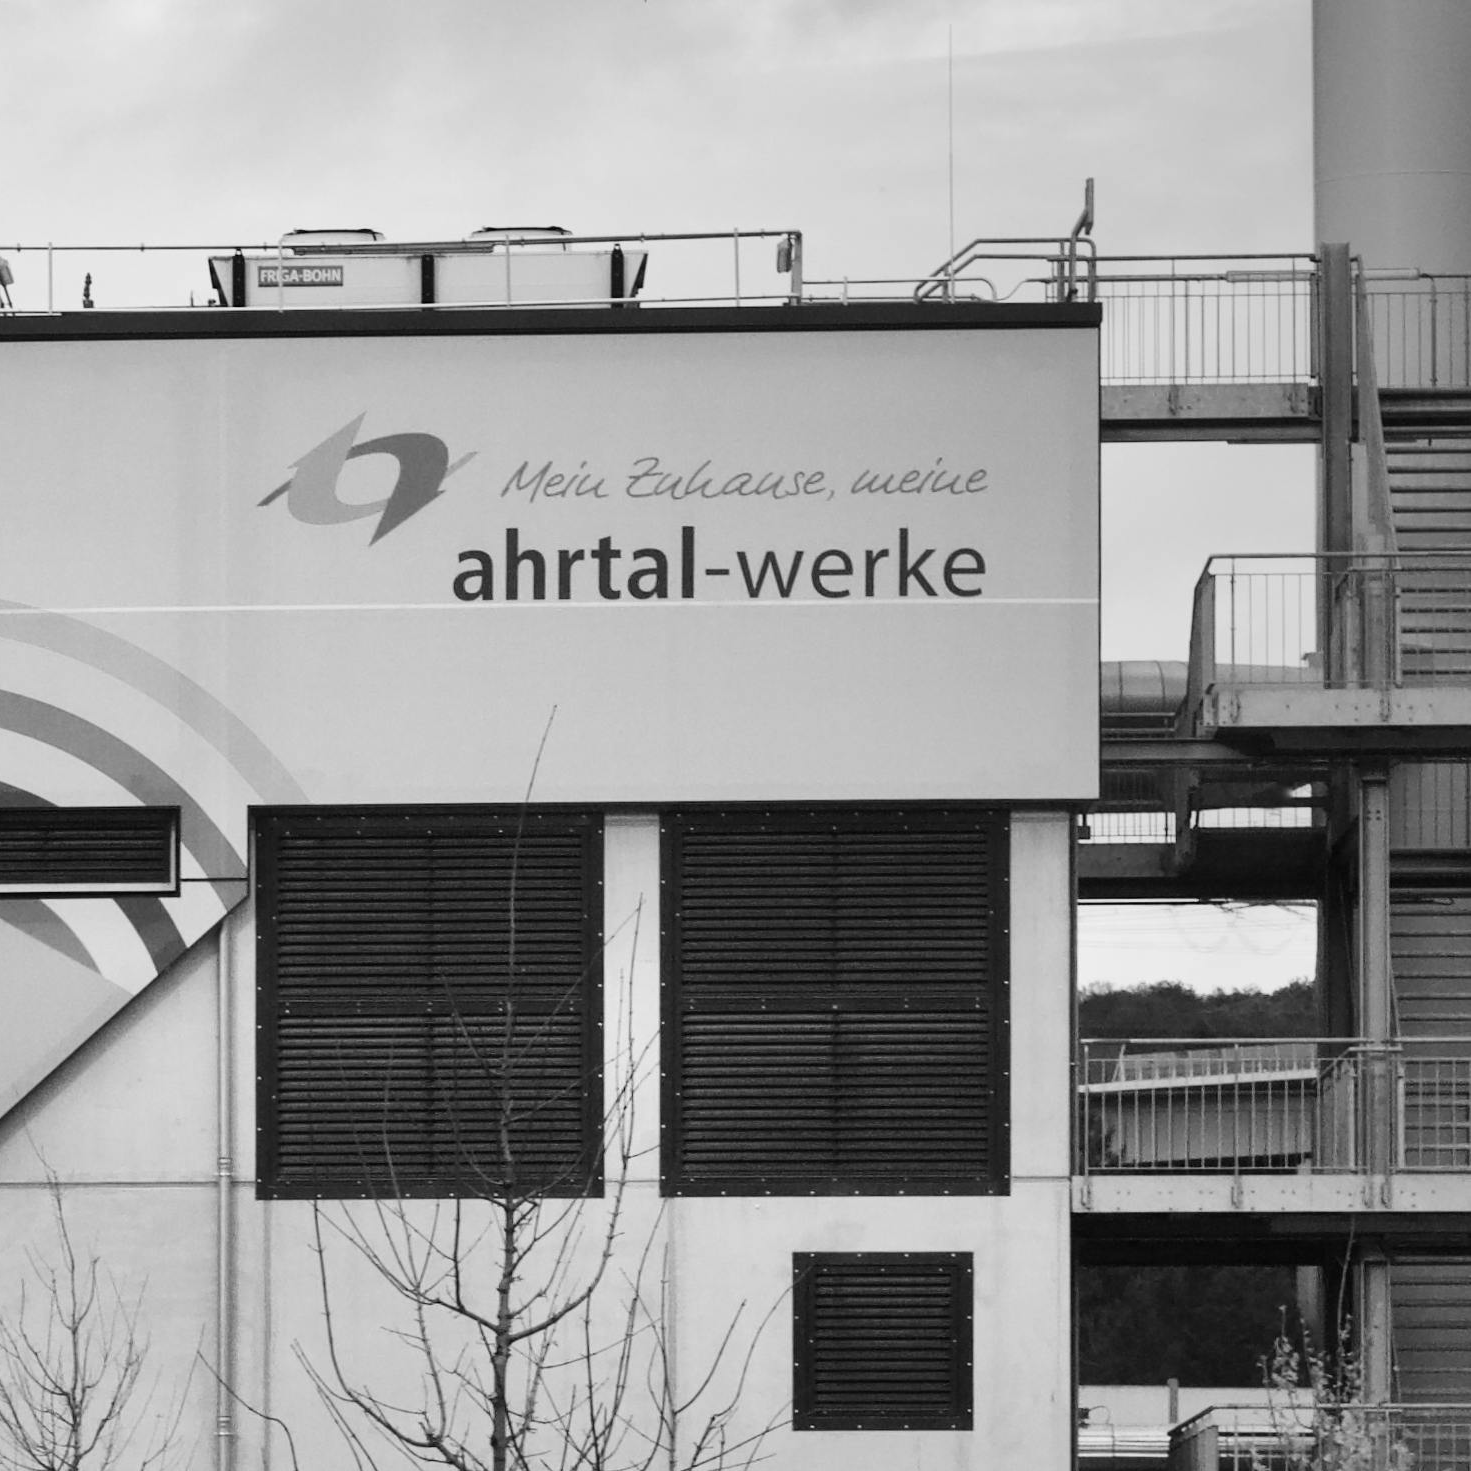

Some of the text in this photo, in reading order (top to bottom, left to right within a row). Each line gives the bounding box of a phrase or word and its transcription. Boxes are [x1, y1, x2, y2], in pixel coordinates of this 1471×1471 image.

[260, 268, 342, 282] FRIGA-BOHN
[500, 456, 989, 504] Mein Zuhause, meine
[452, 526, 987, 602] ahrtal-werke
